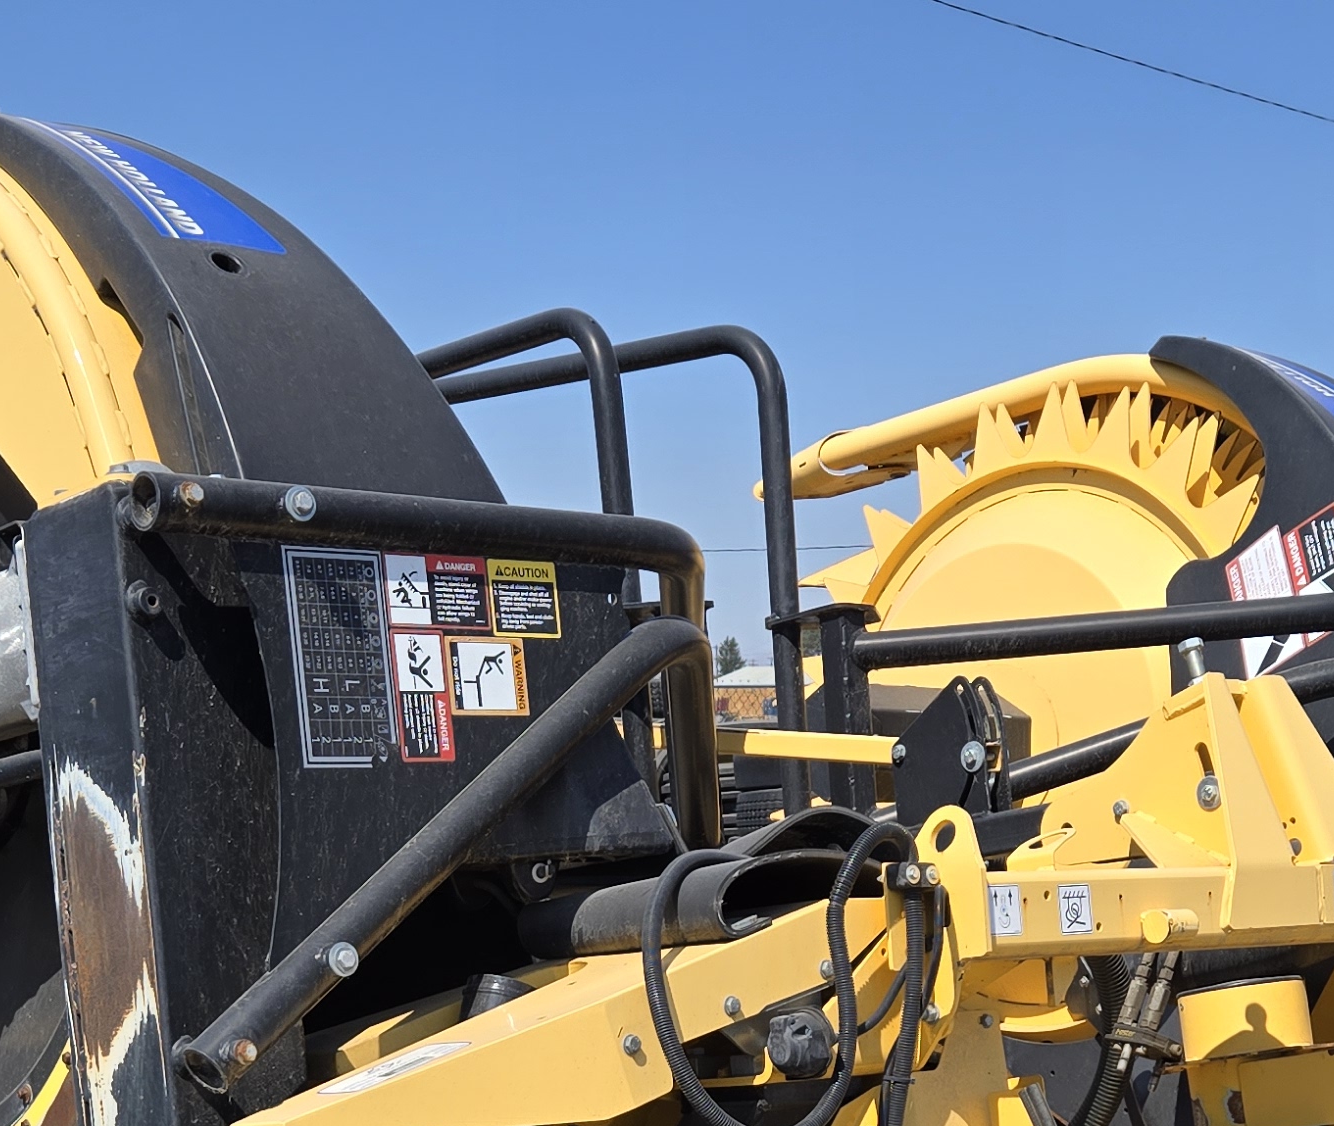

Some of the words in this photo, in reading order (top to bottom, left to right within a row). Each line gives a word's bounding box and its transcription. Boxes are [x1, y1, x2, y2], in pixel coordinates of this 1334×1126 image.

[65, 130, 121, 159] NEW
[109, 159, 204, 235] HOLLAND
[1287, 530, 1305, 576] DANGER
[444, 562, 476, 571] DANGER
[504, 566, 549, 579] CAUTION
[1229, 564, 1246, 601] ANGER
[452, 656, 460, 667] Do
[312, 678, 333, 692] H
[345, 679, 361, 691] L
[515, 660, 526, 710] WARNING
[312, 702, 323, 713] A
[328, 704, 339, 713] B
[344, 703, 355, 714] A
[360, 704, 370, 713] B
[438, 707, 450, 751] DANGER
